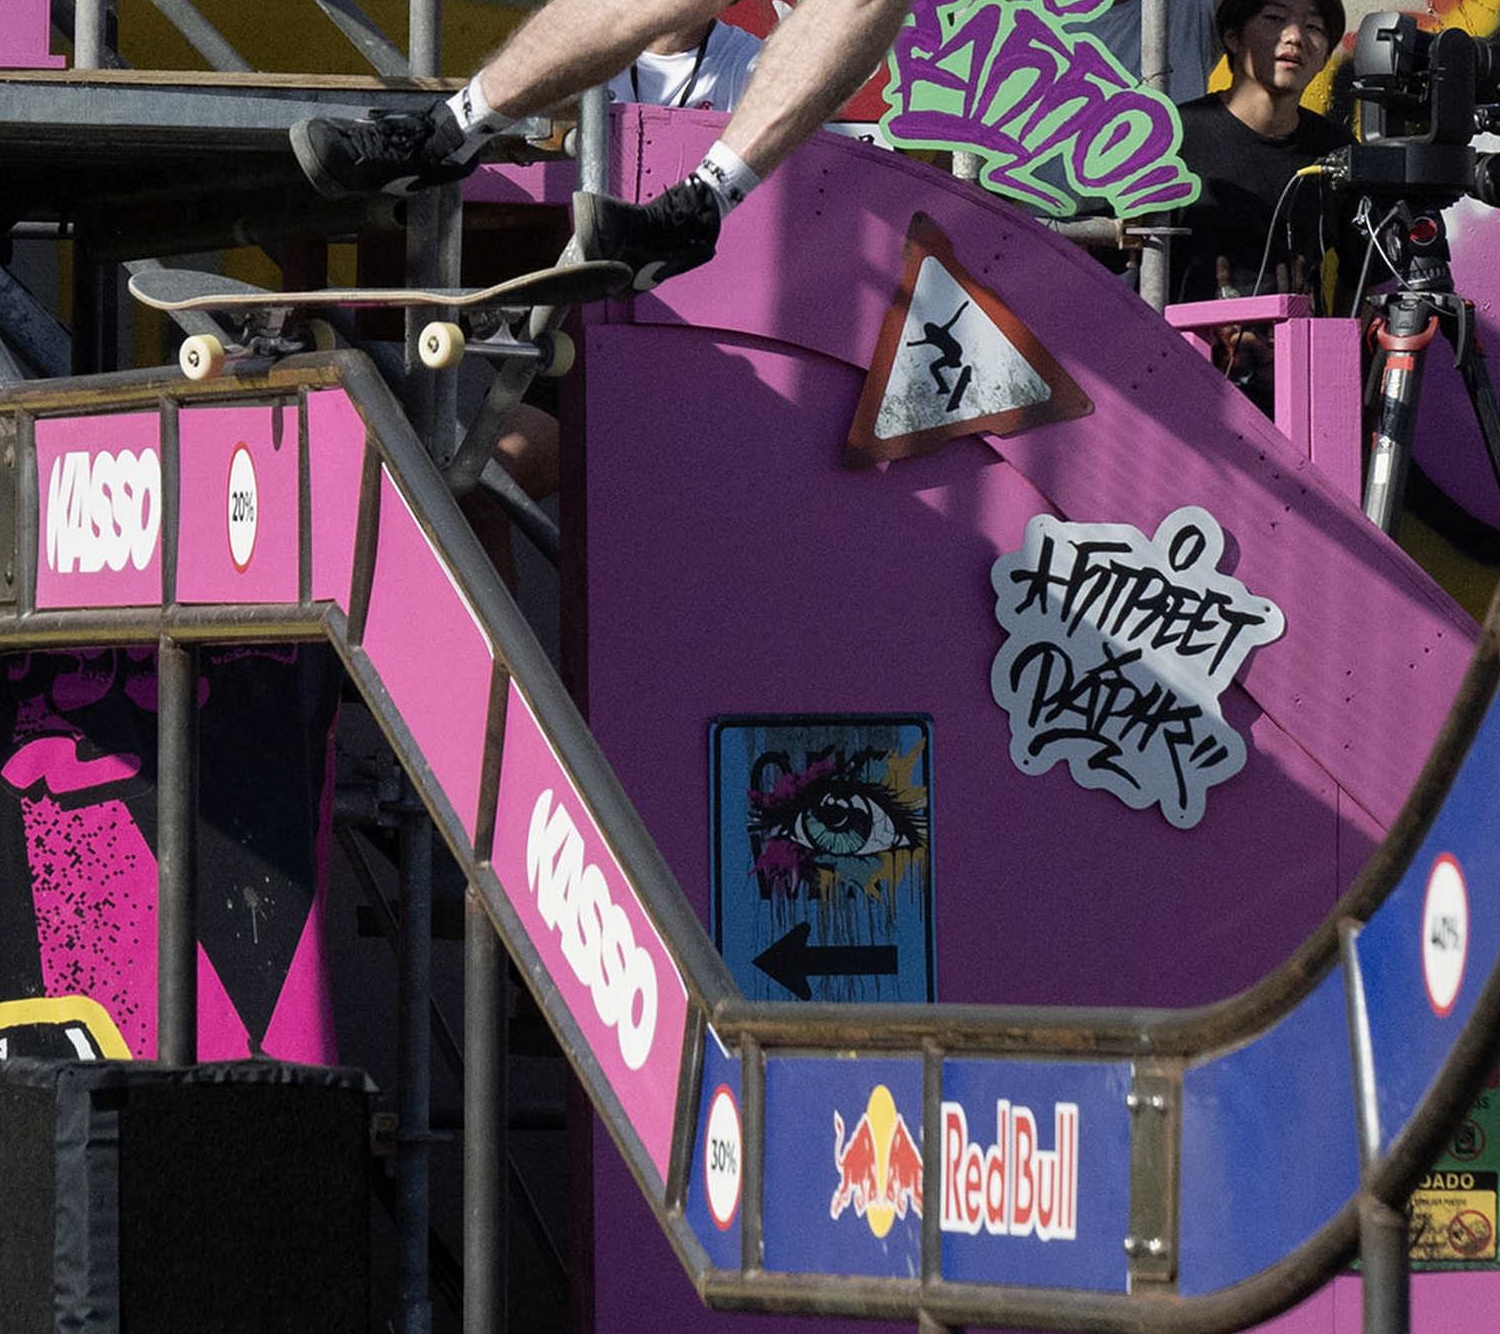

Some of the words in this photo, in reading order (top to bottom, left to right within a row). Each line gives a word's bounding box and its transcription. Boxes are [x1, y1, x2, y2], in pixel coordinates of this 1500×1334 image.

[46, 447, 163, 574] KASSO
[230, 490, 256, 524] 20%
[526, 787, 658, 1069] KASSO
[708, 1137, 739, 1177] 30%
[939, 1098, 1009, 1237] Red
[1007, 1101, 1079, 1242] Bull
